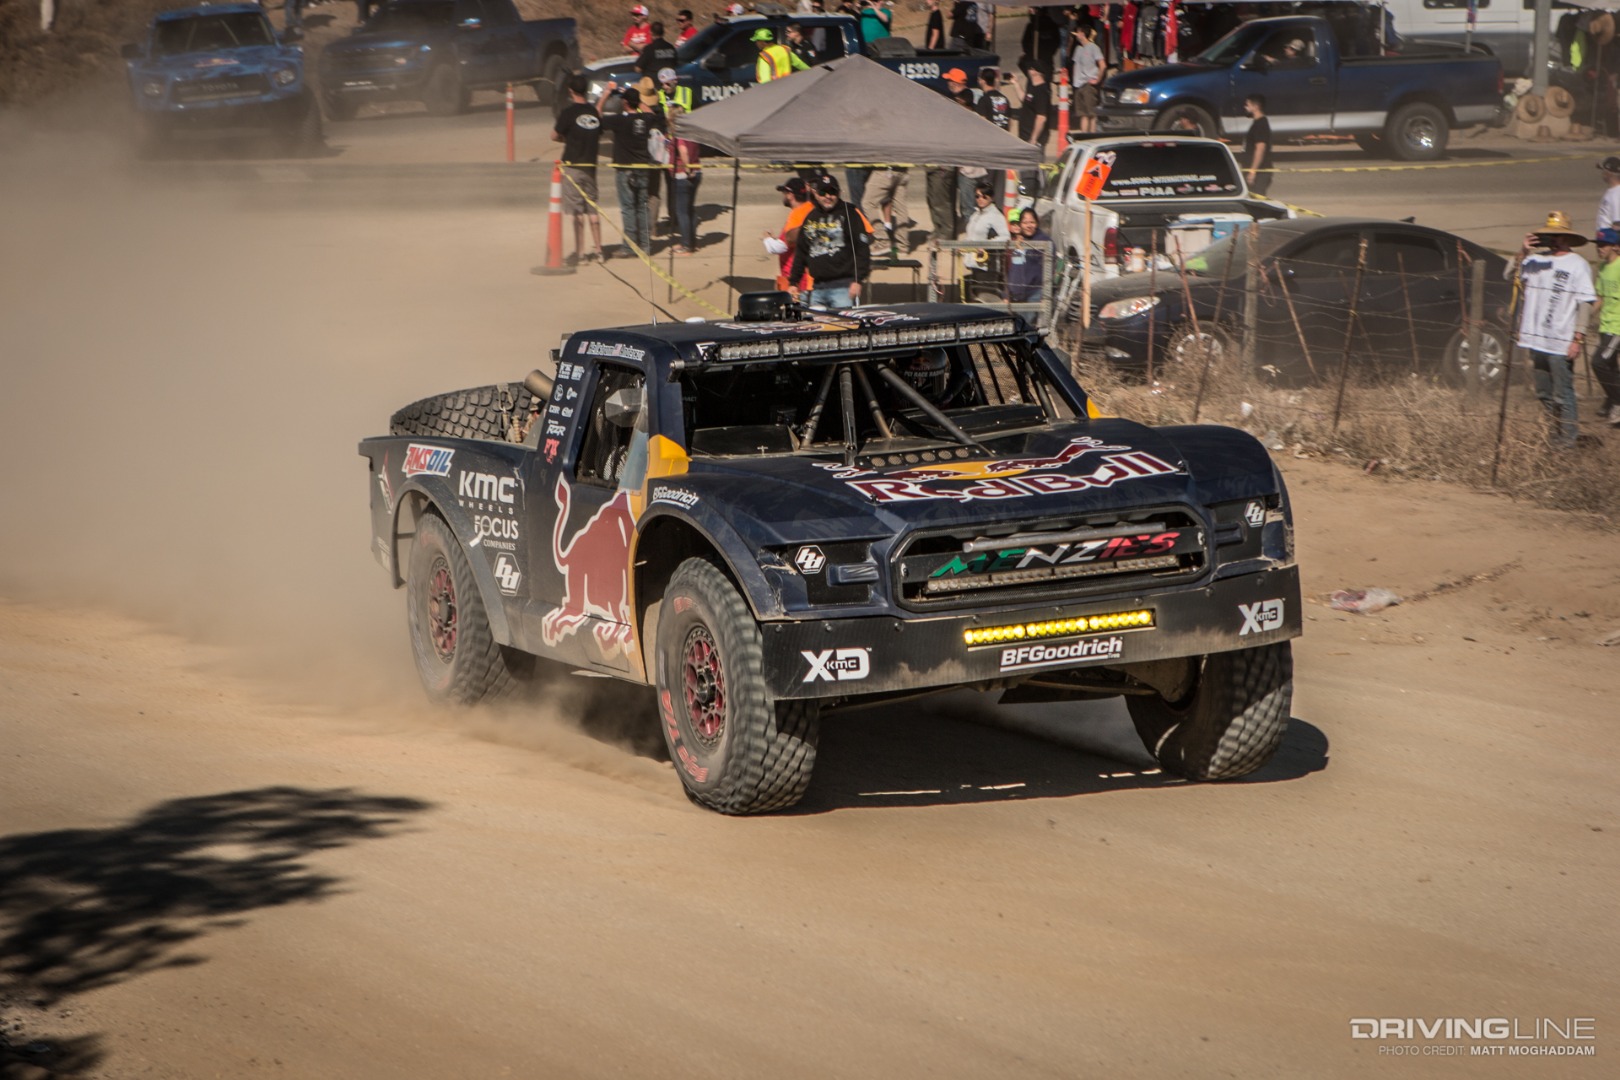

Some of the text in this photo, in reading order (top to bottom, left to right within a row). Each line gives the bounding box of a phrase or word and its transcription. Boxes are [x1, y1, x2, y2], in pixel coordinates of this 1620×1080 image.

[898, 62, 940, 80] 15239
[1139, 186, 1176, 197] PIAA
[404, 446, 452, 474] AMSOIL
[458, 470, 516, 504] KMC
[458, 500, 514, 515] WHEELS
[474, 515, 519, 540] FOCUS
[483, 539, 517, 551] COMPANIES
[928, 531, 1180, 578] MENZIES
[1001, 637, 1122, 666] BFGoodrich
